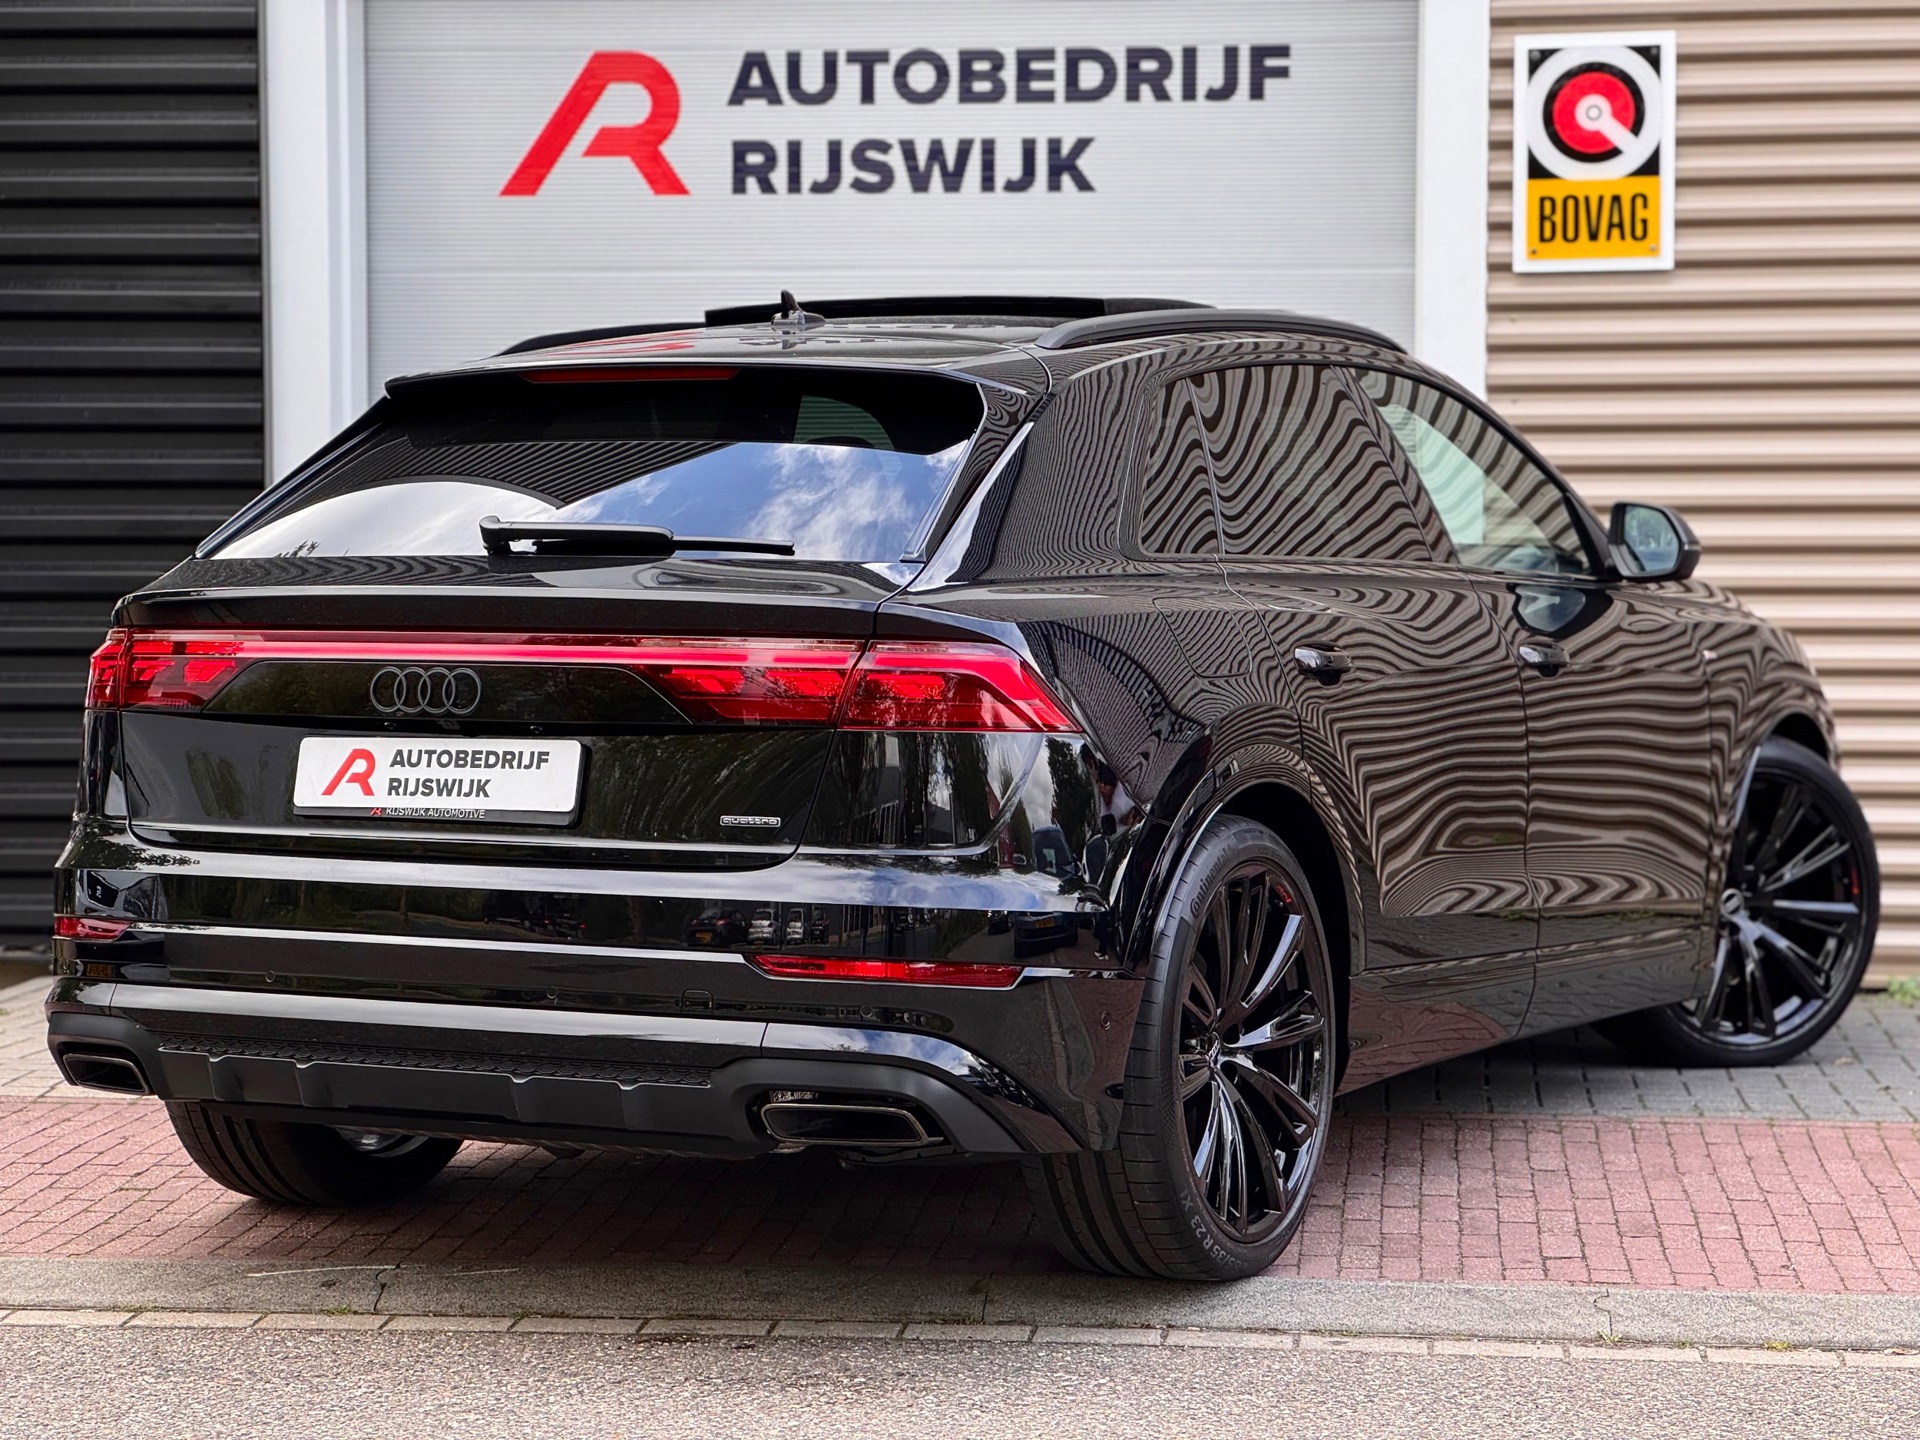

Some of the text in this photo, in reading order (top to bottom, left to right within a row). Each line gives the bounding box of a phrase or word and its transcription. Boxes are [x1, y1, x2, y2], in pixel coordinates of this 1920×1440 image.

[727, 44, 1291, 107] AUTOBEDRIJF
[732, 136, 1097, 196] RIJSWIJK
[1539, 192, 1649, 243] BOVAG
[389, 748, 550, 770] AUTOBEDRIJF
[387, 777, 492, 798] RIJSWIJK
[386, 807, 425, 817] RIJSWIJK
[428, 808, 486, 819] AUTOMOTIVE
[722, 817, 778, 825] quattro
[1190, 847, 1230, 919] Continental
